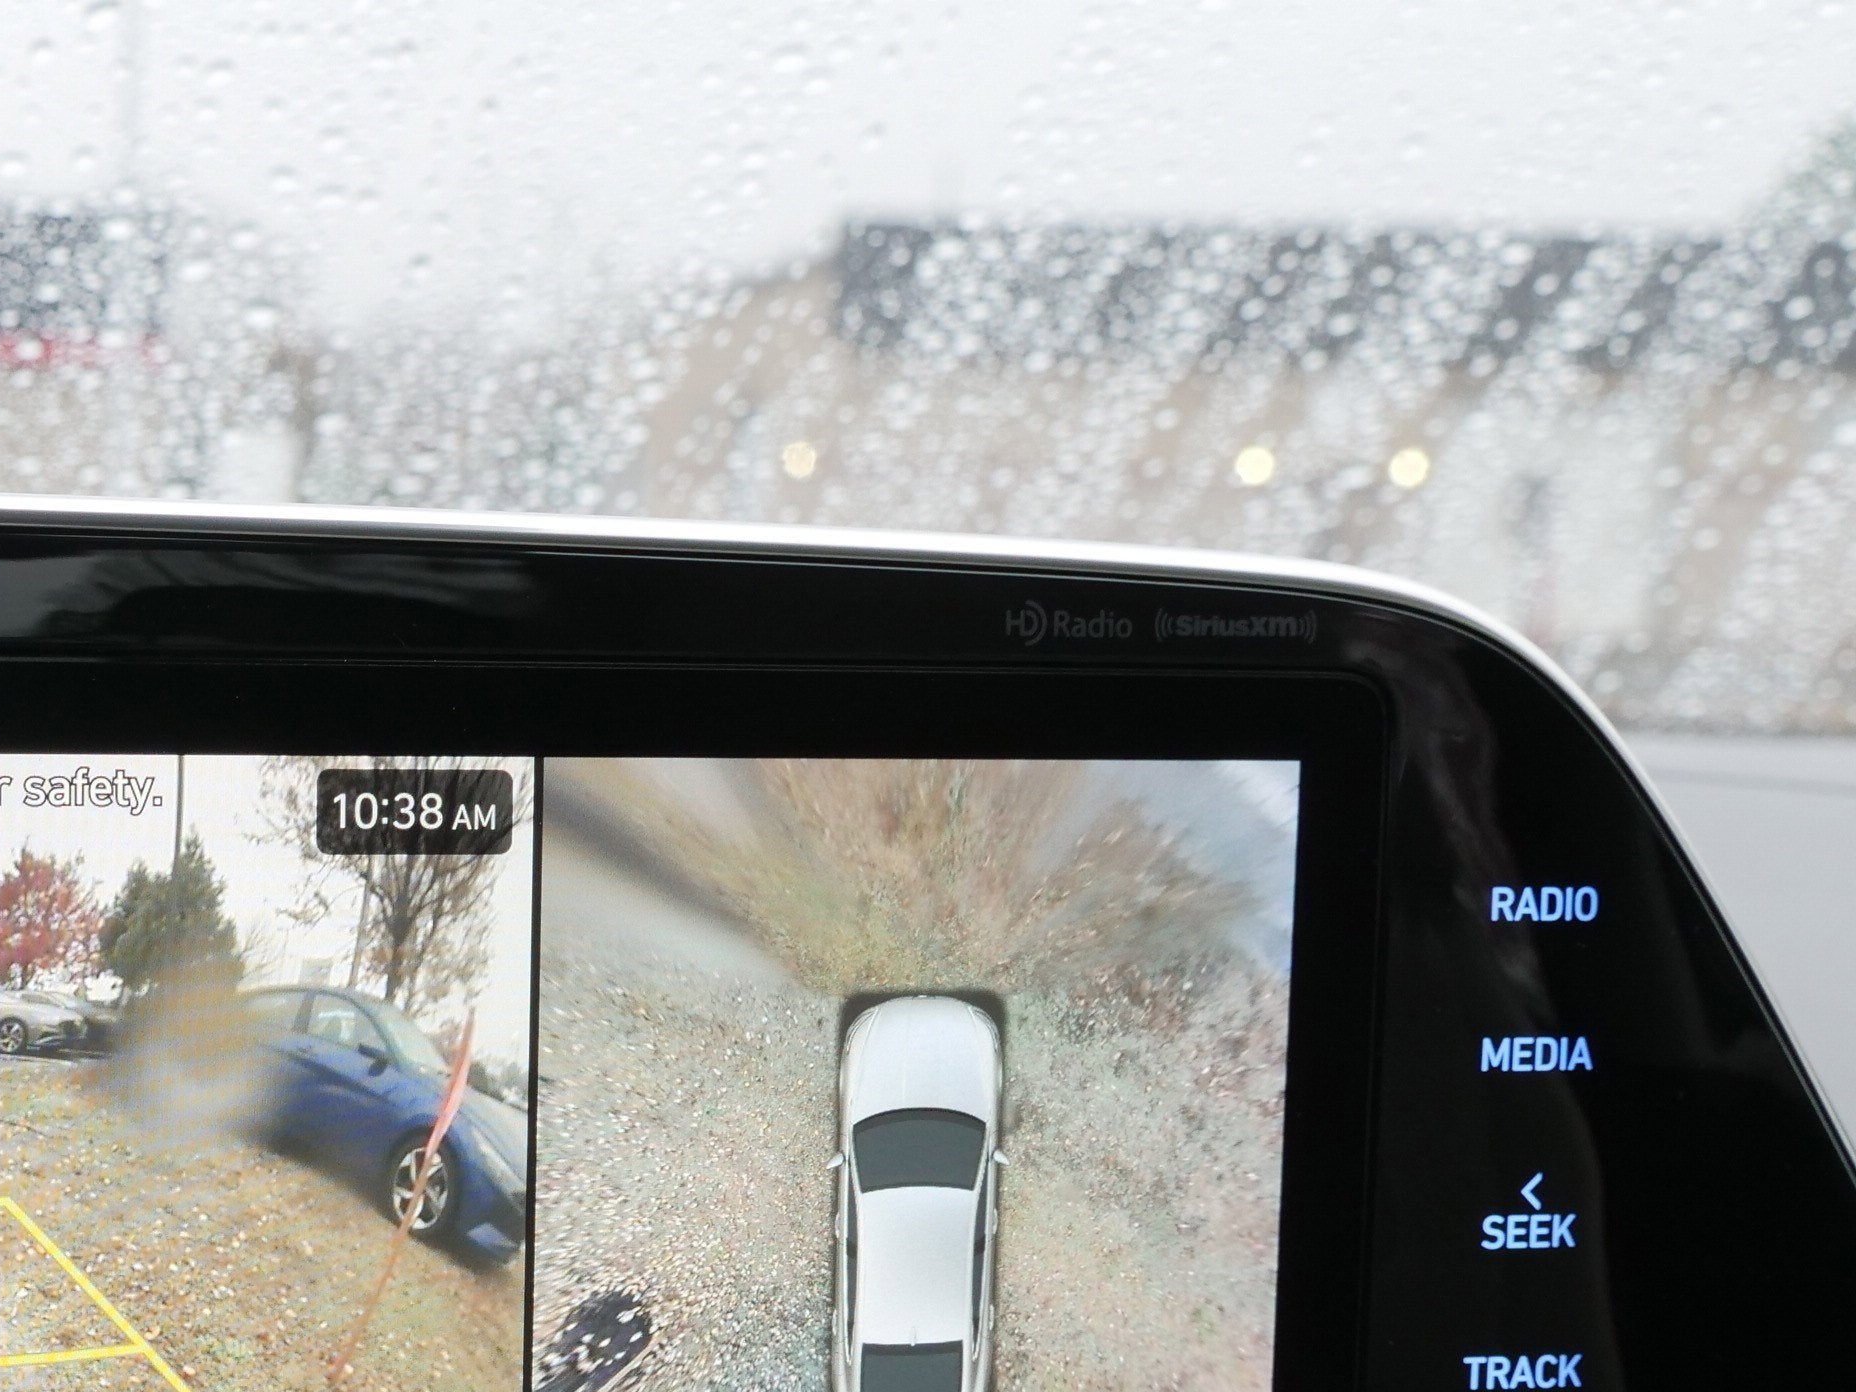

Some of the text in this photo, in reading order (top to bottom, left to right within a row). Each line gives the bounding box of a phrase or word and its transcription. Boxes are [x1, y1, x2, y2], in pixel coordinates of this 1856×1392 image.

[1053, 608, 1134, 640] Radio
[22, 766, 164, 817] safety.
[333, 792, 496, 831] 10:38 AM
[1490, 886, 1600, 923] RADIO
[1480, 1036, 1595, 1074] MEDIA
[1480, 1214, 1578, 1252] SEEK
[1462, 1353, 1584, 1392] TRACK
